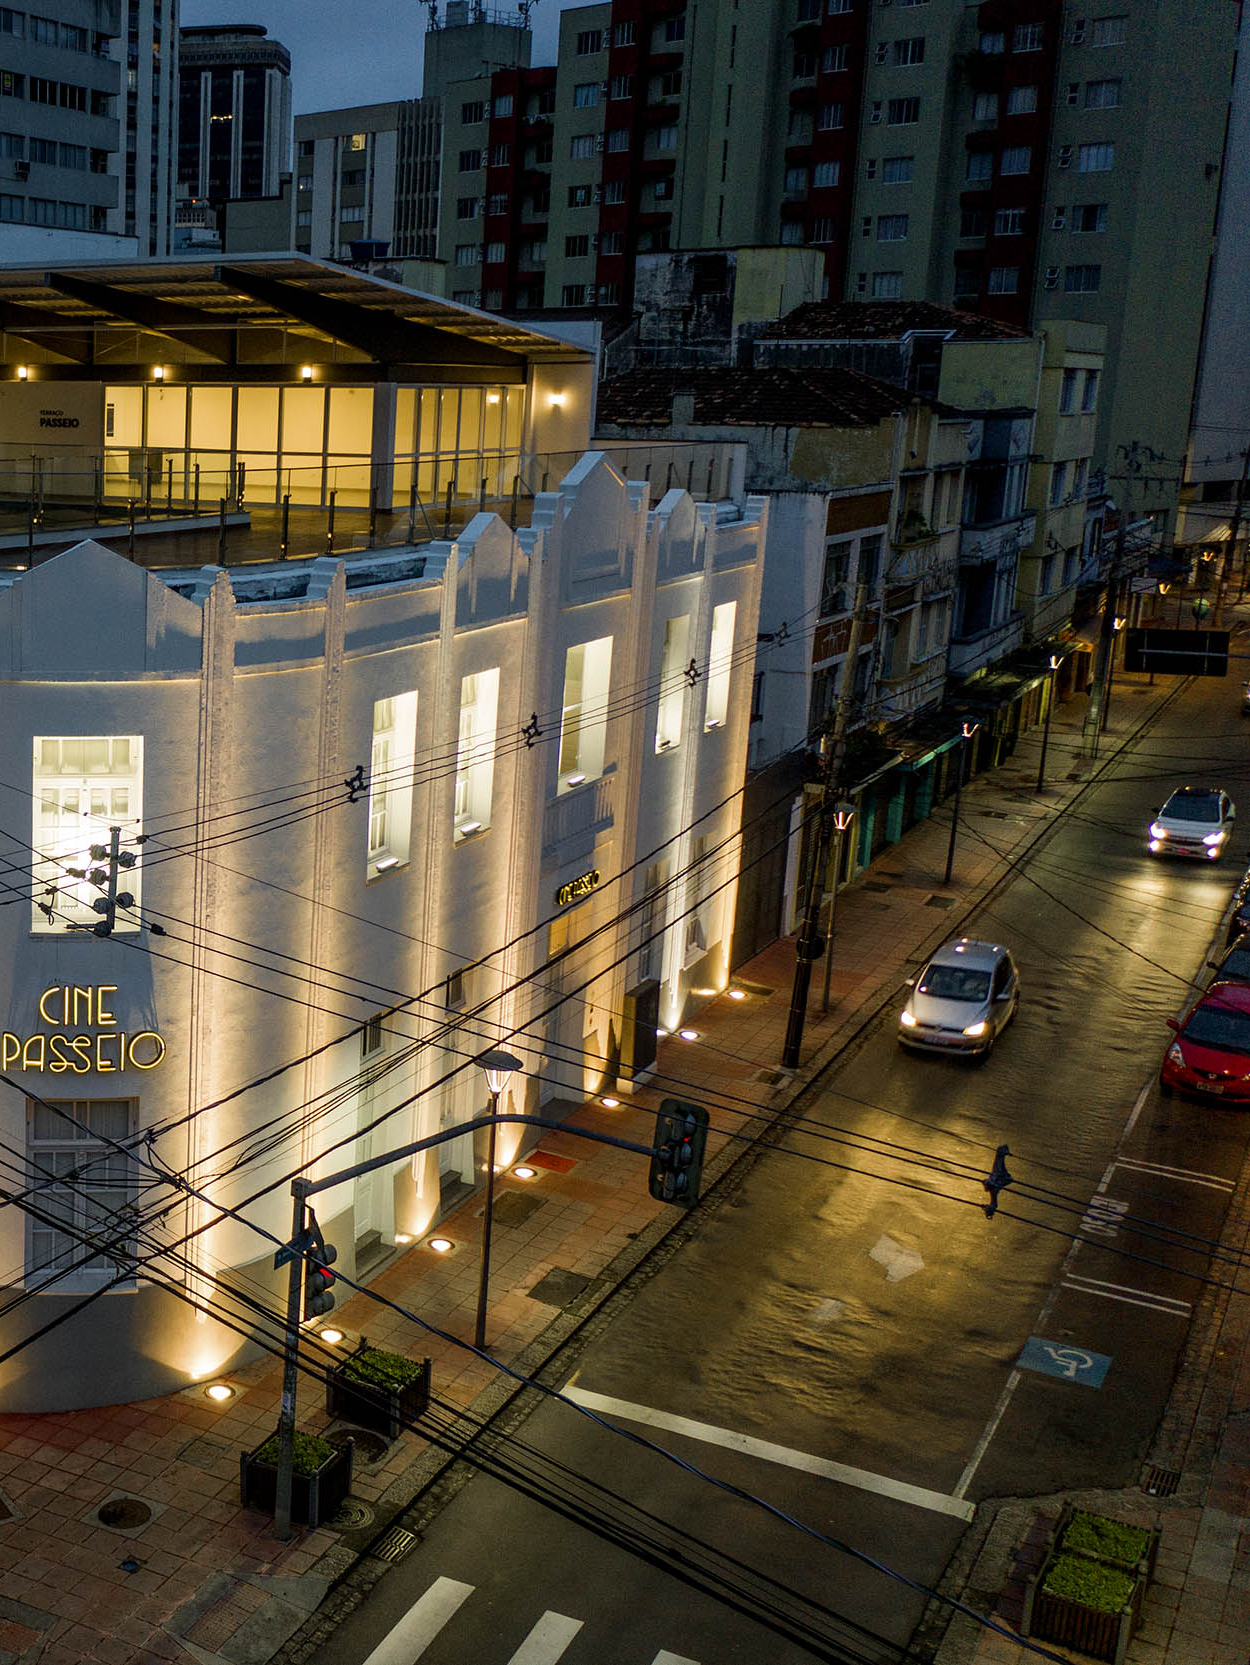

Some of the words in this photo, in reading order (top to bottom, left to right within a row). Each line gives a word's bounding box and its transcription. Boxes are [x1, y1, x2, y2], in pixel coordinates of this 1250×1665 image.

[40, 418, 79, 428] PASSEIO
[39, 985, 119, 1026] CINE
[2, 1031, 167, 1074] PASSEIO
